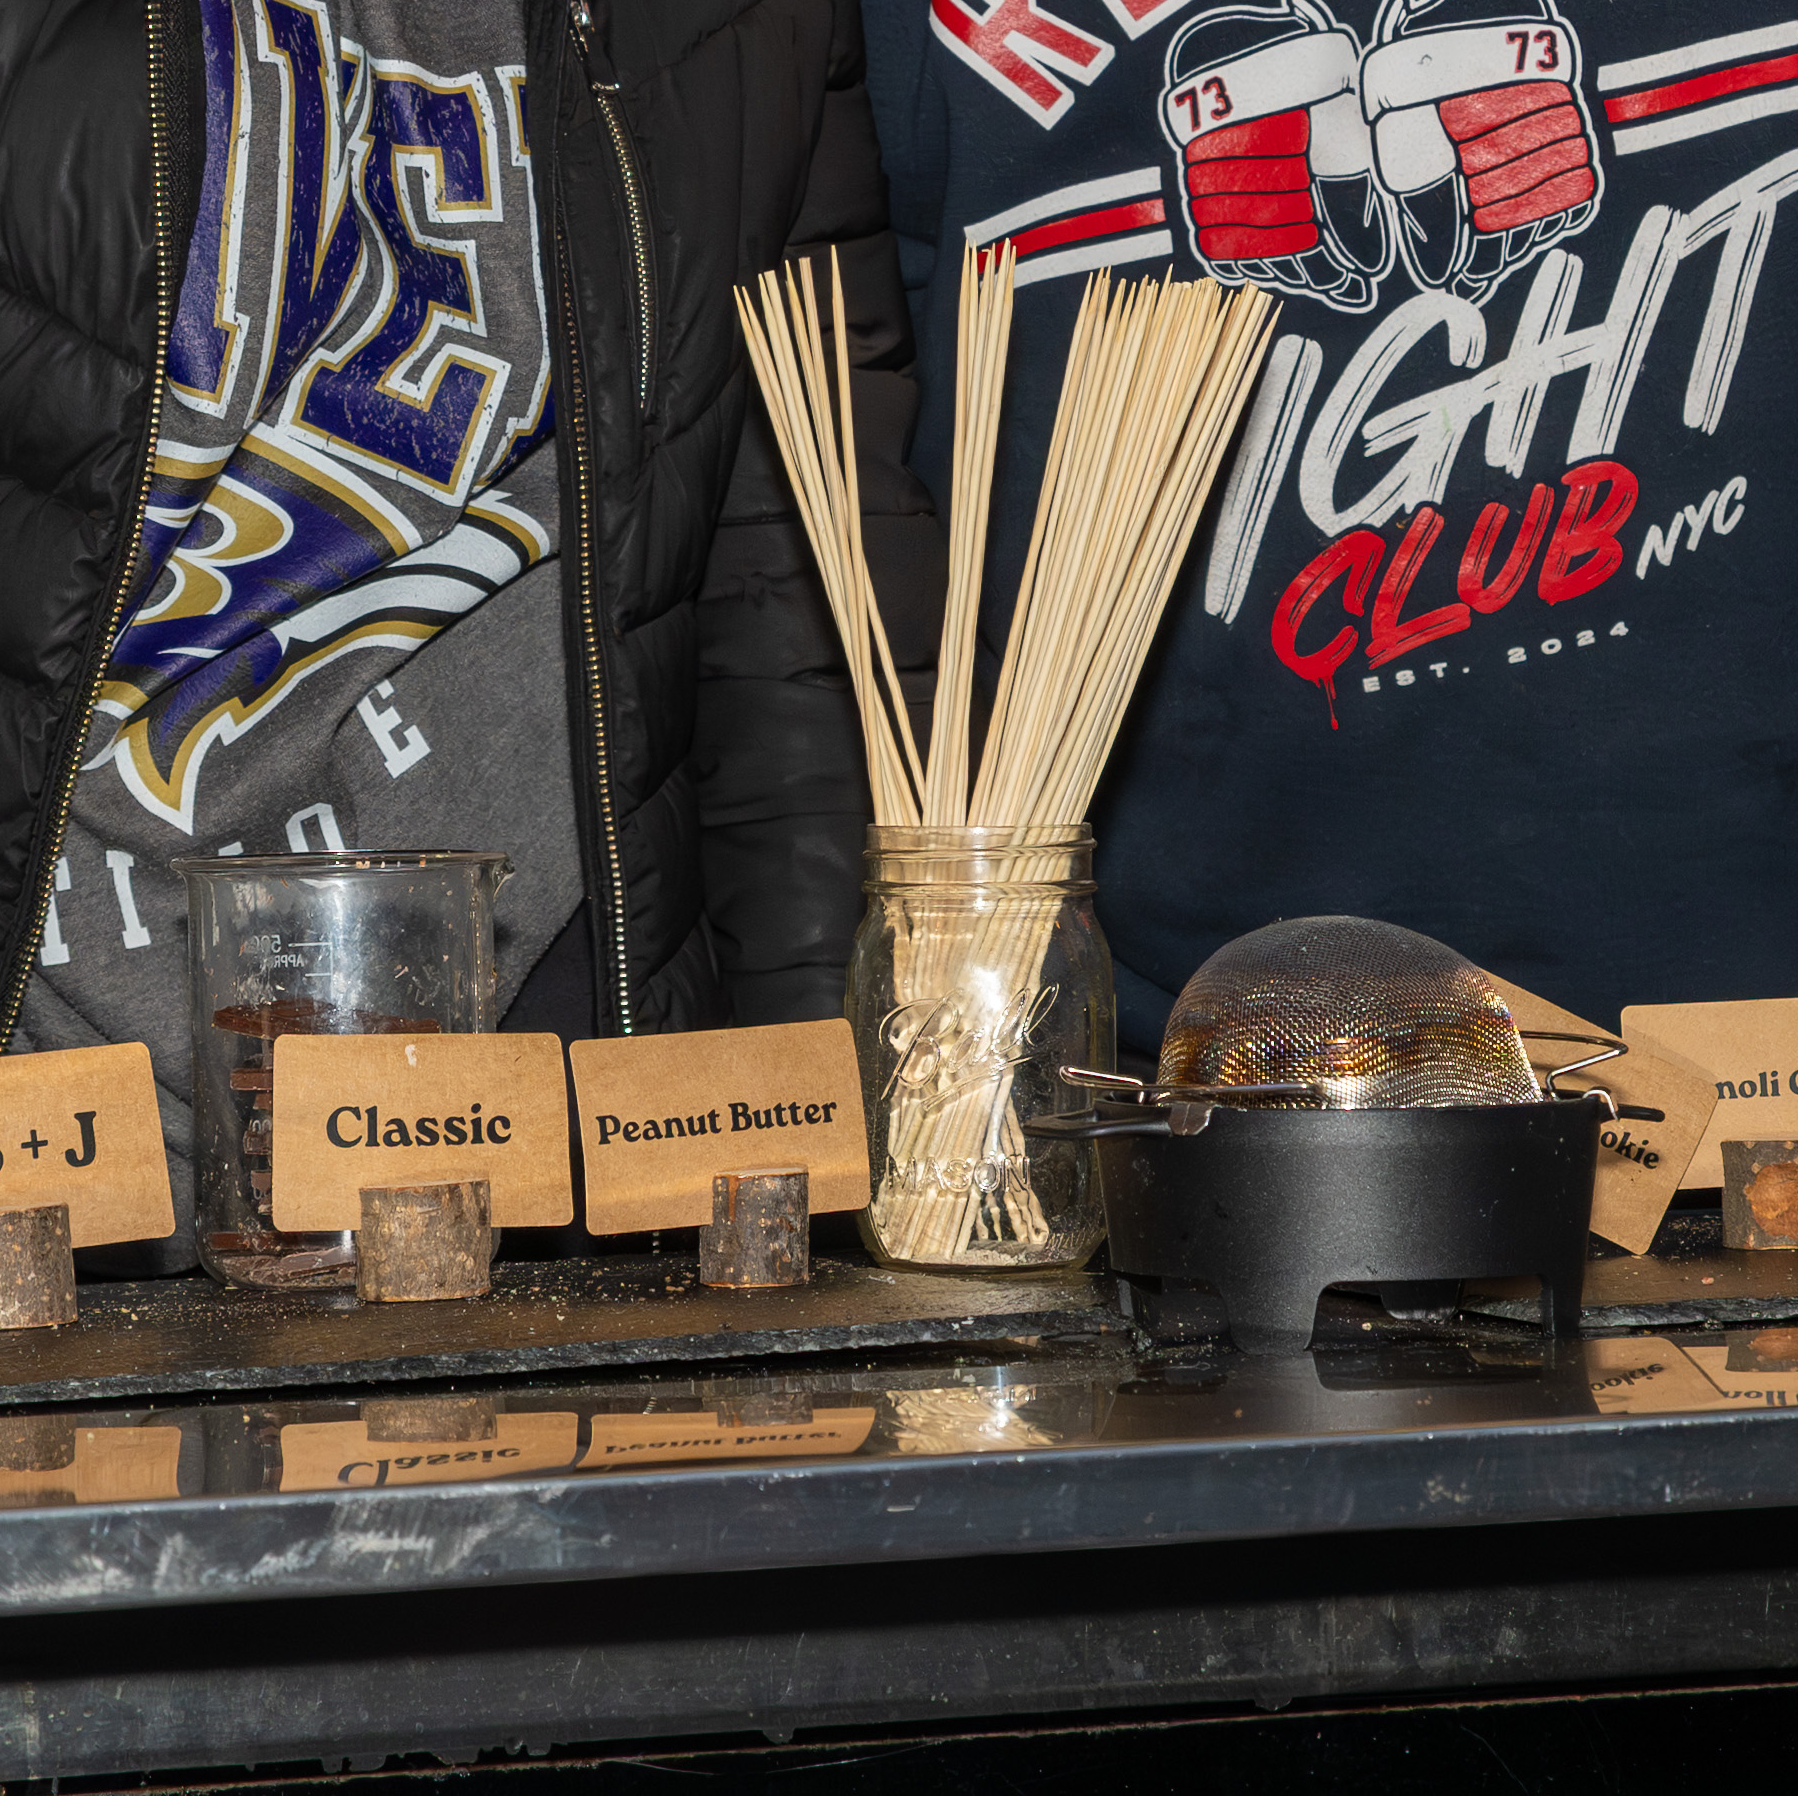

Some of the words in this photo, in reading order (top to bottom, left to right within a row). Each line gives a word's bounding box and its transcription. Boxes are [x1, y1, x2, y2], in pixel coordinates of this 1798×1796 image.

[1506, 29, 1560, 73] 73
[1175, 75, 1233, 131] 73
[1271, 460, 1640, 699] CLUB
[1636, 474, 1749, 580] NYC
[1361, 659, 1473, 695] EST.
[1507, 620, 1632, 664] 2024
[878, 982, 1060, 1101] Ball
[1715, 1070, 1781, 1100] noli
[20, 1129, 49, 1160] +
[64, 1110, 98, 1168] J
[325, 1102, 513, 1148] Classic
[595, 1108, 722, 1145] Peanut
[727, 1100, 838, 1133] Butter
[1600, 1129, 1660, 1170] okie
[885, 1153, 1032, 1194] MASON
